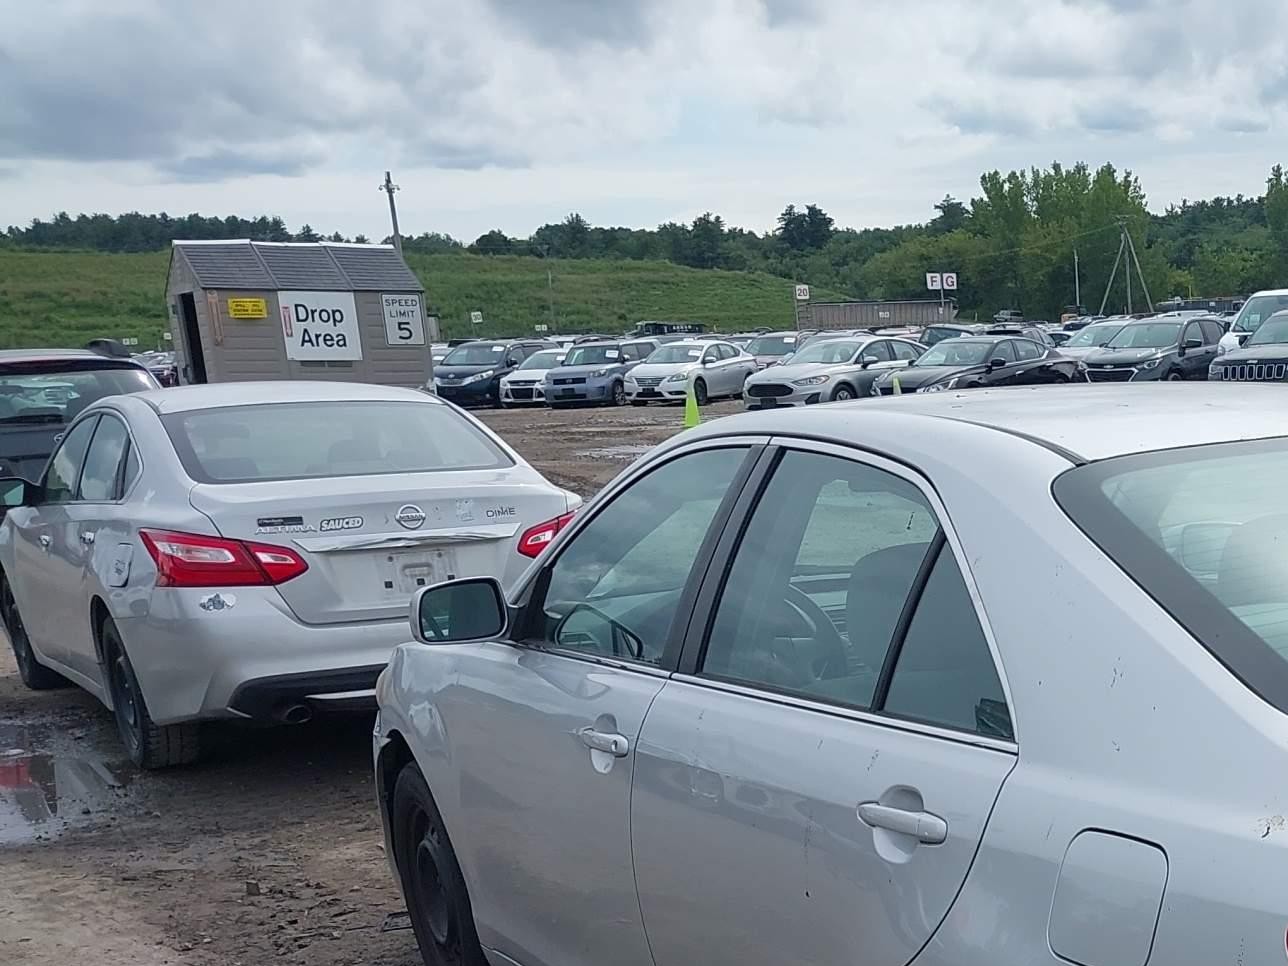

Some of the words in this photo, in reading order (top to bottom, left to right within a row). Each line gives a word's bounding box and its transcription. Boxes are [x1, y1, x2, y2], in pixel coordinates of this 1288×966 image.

[930, 275, 938, 287] F
[945, 275, 955, 287] G
[797, 288, 808, 297] 20
[384, 298, 418, 308] SPEED
[295, 303, 344, 327] Drop
[389, 310, 415, 319] LIMIT
[398, 322, 413, 340] 5
[301, 328, 347, 348] Area
[321, 517, 363, 531] SAUCED
